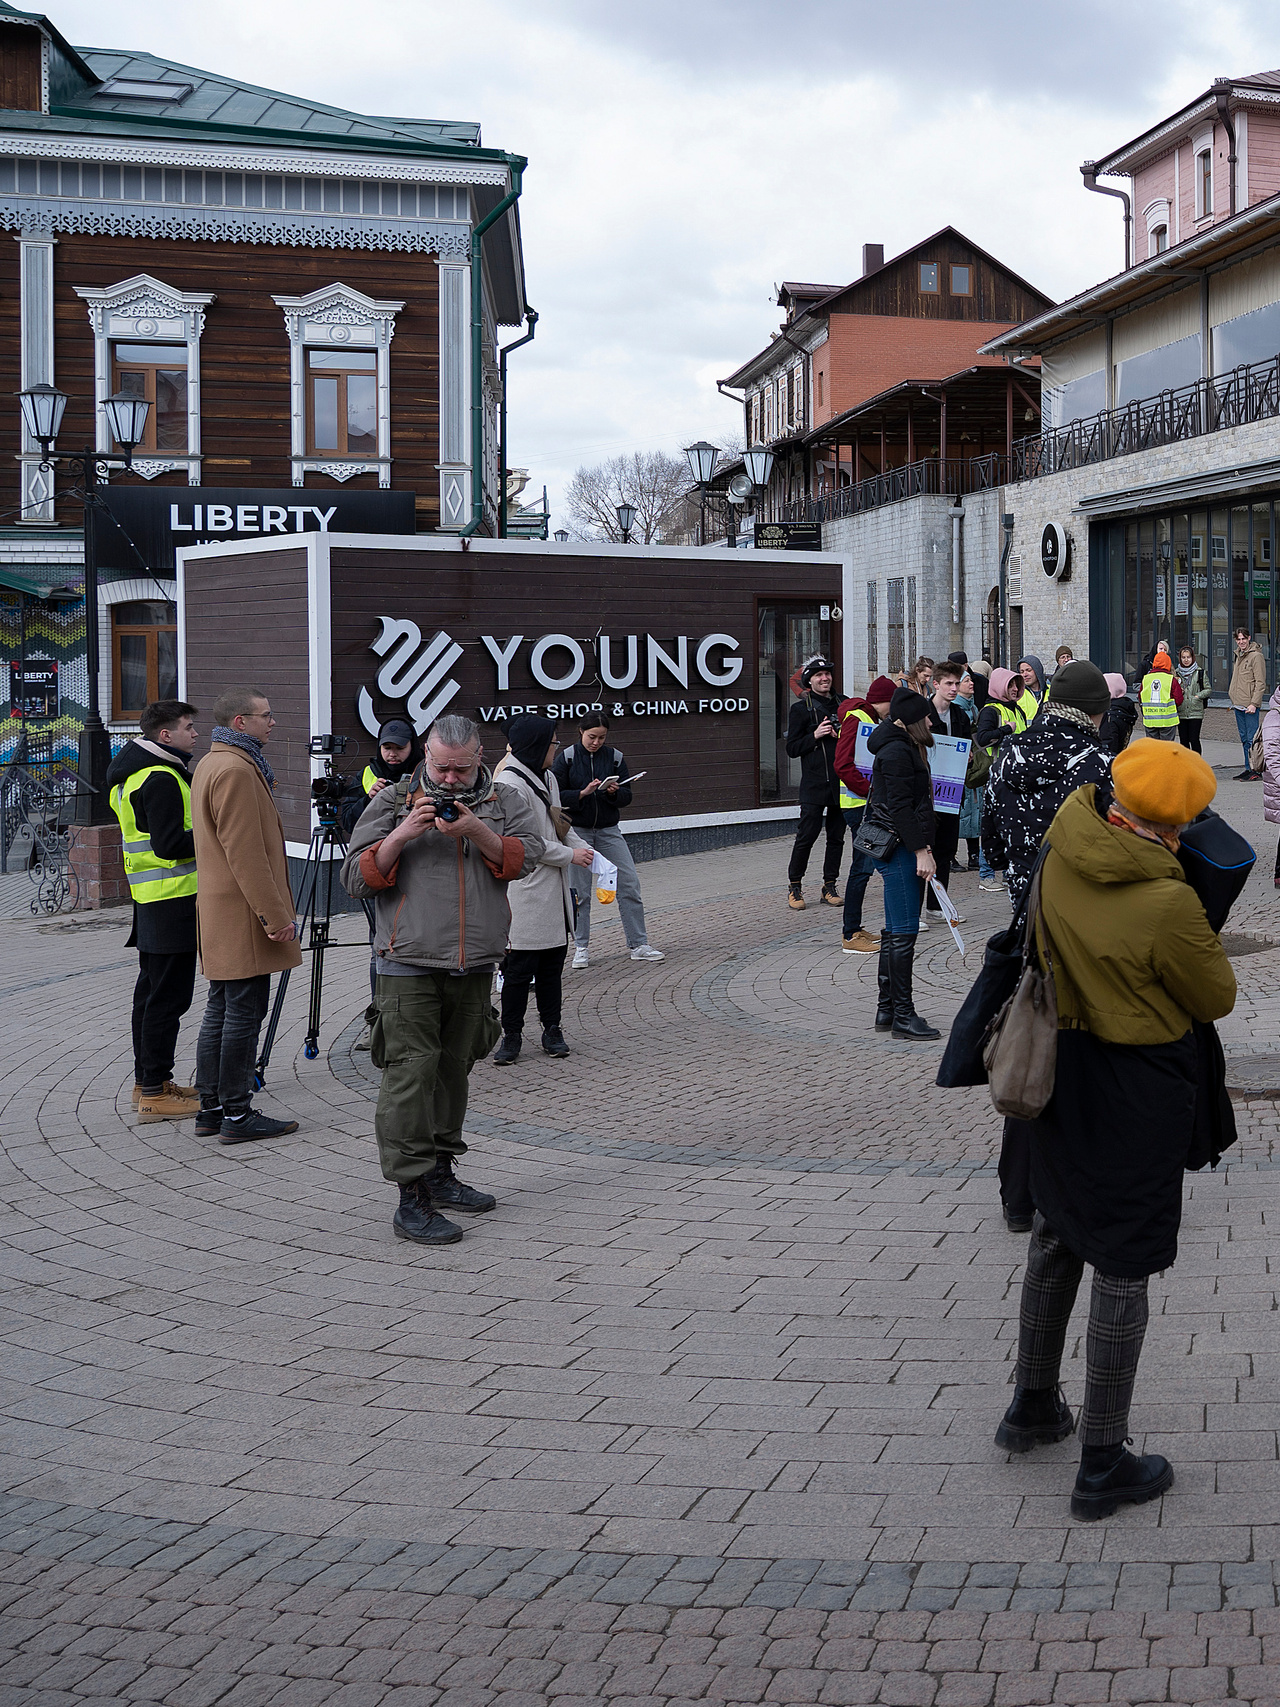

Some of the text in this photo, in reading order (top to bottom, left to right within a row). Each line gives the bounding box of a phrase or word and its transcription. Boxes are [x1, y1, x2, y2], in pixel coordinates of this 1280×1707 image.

[170, 503, 338, 532] LIBERTY
[480, 632, 744, 691] YOUNG
[612, 702, 625, 717] &
[633, 700, 689, 716] CHINA
[699, 698, 750, 713] FOOD
